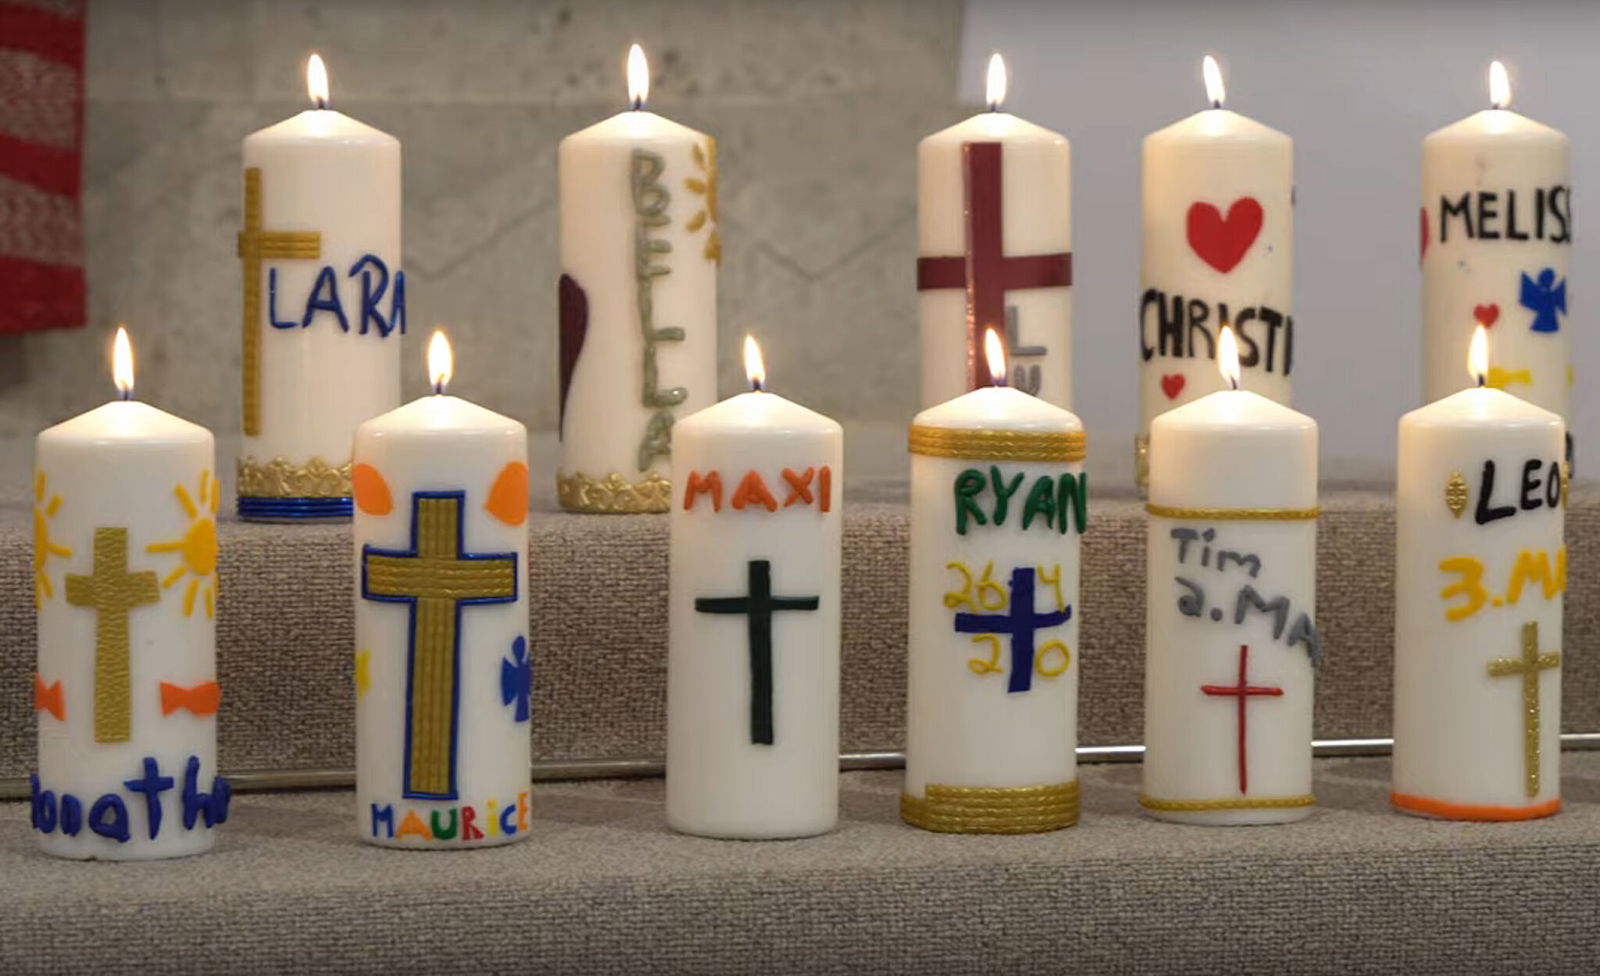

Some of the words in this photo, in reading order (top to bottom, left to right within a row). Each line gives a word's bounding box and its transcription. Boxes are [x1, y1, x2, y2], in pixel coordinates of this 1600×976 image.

[1439, 185, 1572, 244] MELIS
[683, 464, 831, 513] MAXI
[954, 465, 1087, 536] RYAN
